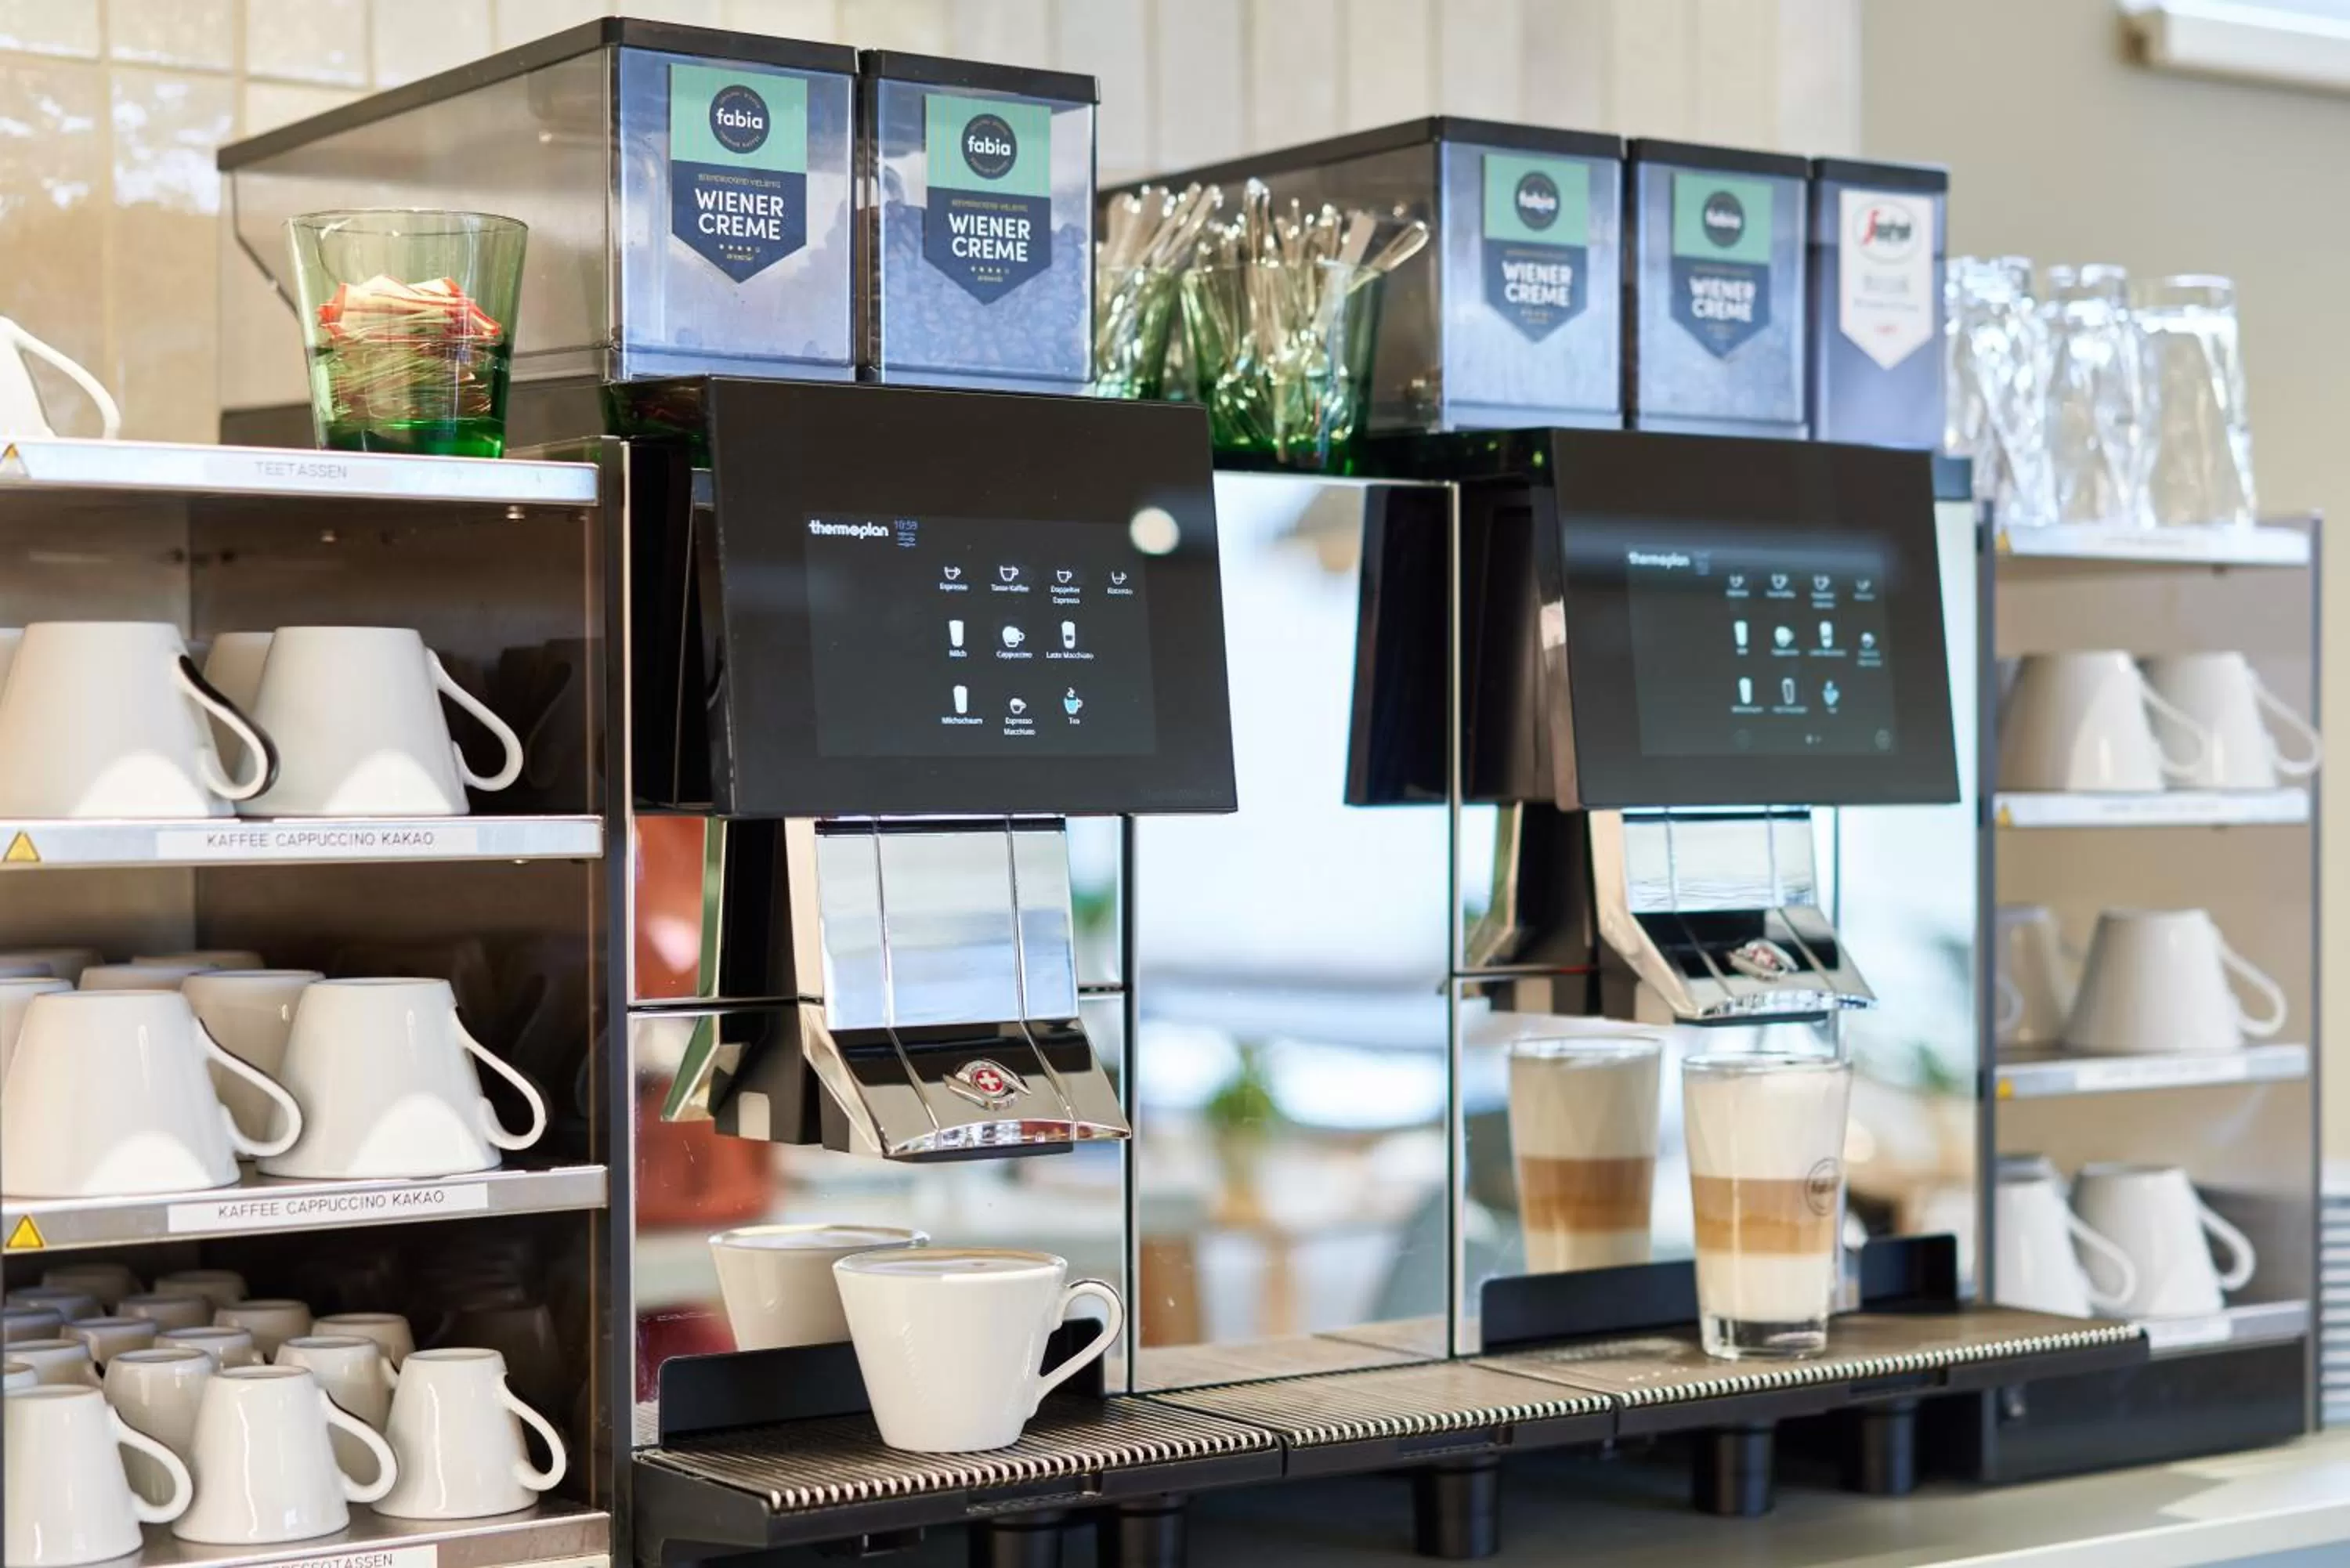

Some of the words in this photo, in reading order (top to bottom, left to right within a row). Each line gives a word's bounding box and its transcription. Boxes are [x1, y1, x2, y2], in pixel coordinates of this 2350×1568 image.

[716, 107, 763, 130] fabia
[967, 135, 1011, 157] fabia
[695, 188, 784, 217] WIENER
[698, 213, 781, 240] CREME
[948, 213, 1031, 240] WIENER
[952, 237, 1029, 262] CREME
[1502, 260, 1573, 287] WIENER
[1504, 281, 1570, 307] CREME
[254, 461, 347, 479] TEETASSEN
[808, 519, 889, 539] thermoplan
[207, 833, 269, 847] KAFFEE
[275, 832, 376, 847] CAPPUCCINO
[381, 831, 434, 846] KAKAO
[219, 1202, 279, 1217] KAFFEE
[287, 1194, 387, 1216] CAPPUCCINO
[392, 1190, 444, 1206] KAKAO
